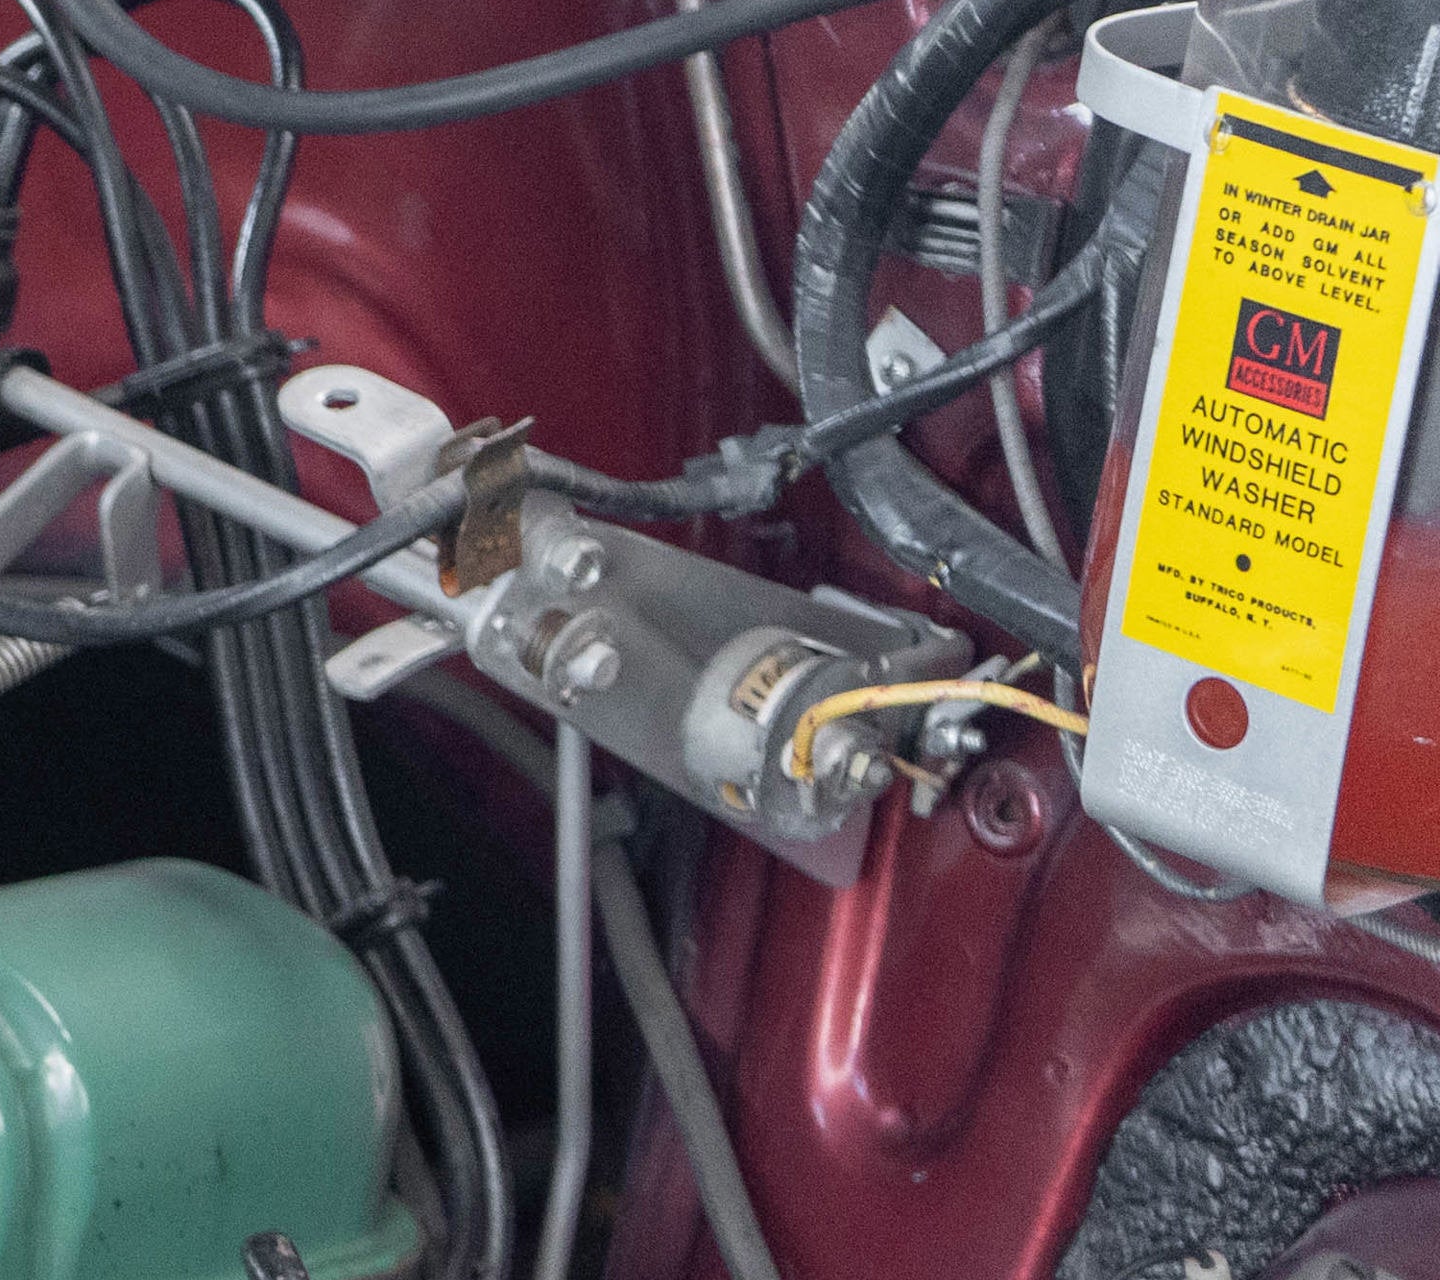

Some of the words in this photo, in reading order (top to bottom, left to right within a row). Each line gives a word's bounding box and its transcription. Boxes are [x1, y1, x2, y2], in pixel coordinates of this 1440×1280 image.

[1218, 207, 1241, 224] OR
[1260, 222, 1295, 243] ADD
[1313, 238, 1338, 255] GM
[1354, 250, 1387, 270] ALL
[1224, 182, 1239, 198] IN
[1244, 188, 1302, 218] WINTER
[1306, 208, 1355, 233] DRAIN
[1360, 225, 1391, 244] JAR
[1213, 246, 1235, 265] TO
[1248, 260, 1306, 288] ABOVE
[1320, 283, 1381, 313] LEVEL.
[1215, 227, 1285, 261] SEASON
[1302, 255, 1386, 291] SOLVENT
[1246, 308, 1329, 376] GM
[1235, 364, 1322, 408] ACCESSORIES
[1181, 423, 1343, 497] WINDSHIELD
[1192, 394, 1349, 465] AUTOMATIC
[1201, 466, 1317, 524] WASHER
[1158, 489, 1266, 540] STANDARD
[1274, 530, 1344, 568] MODEL
[1190, 575, 1204, 586] BY
[1210, 582, 1245, 602] TRICO
